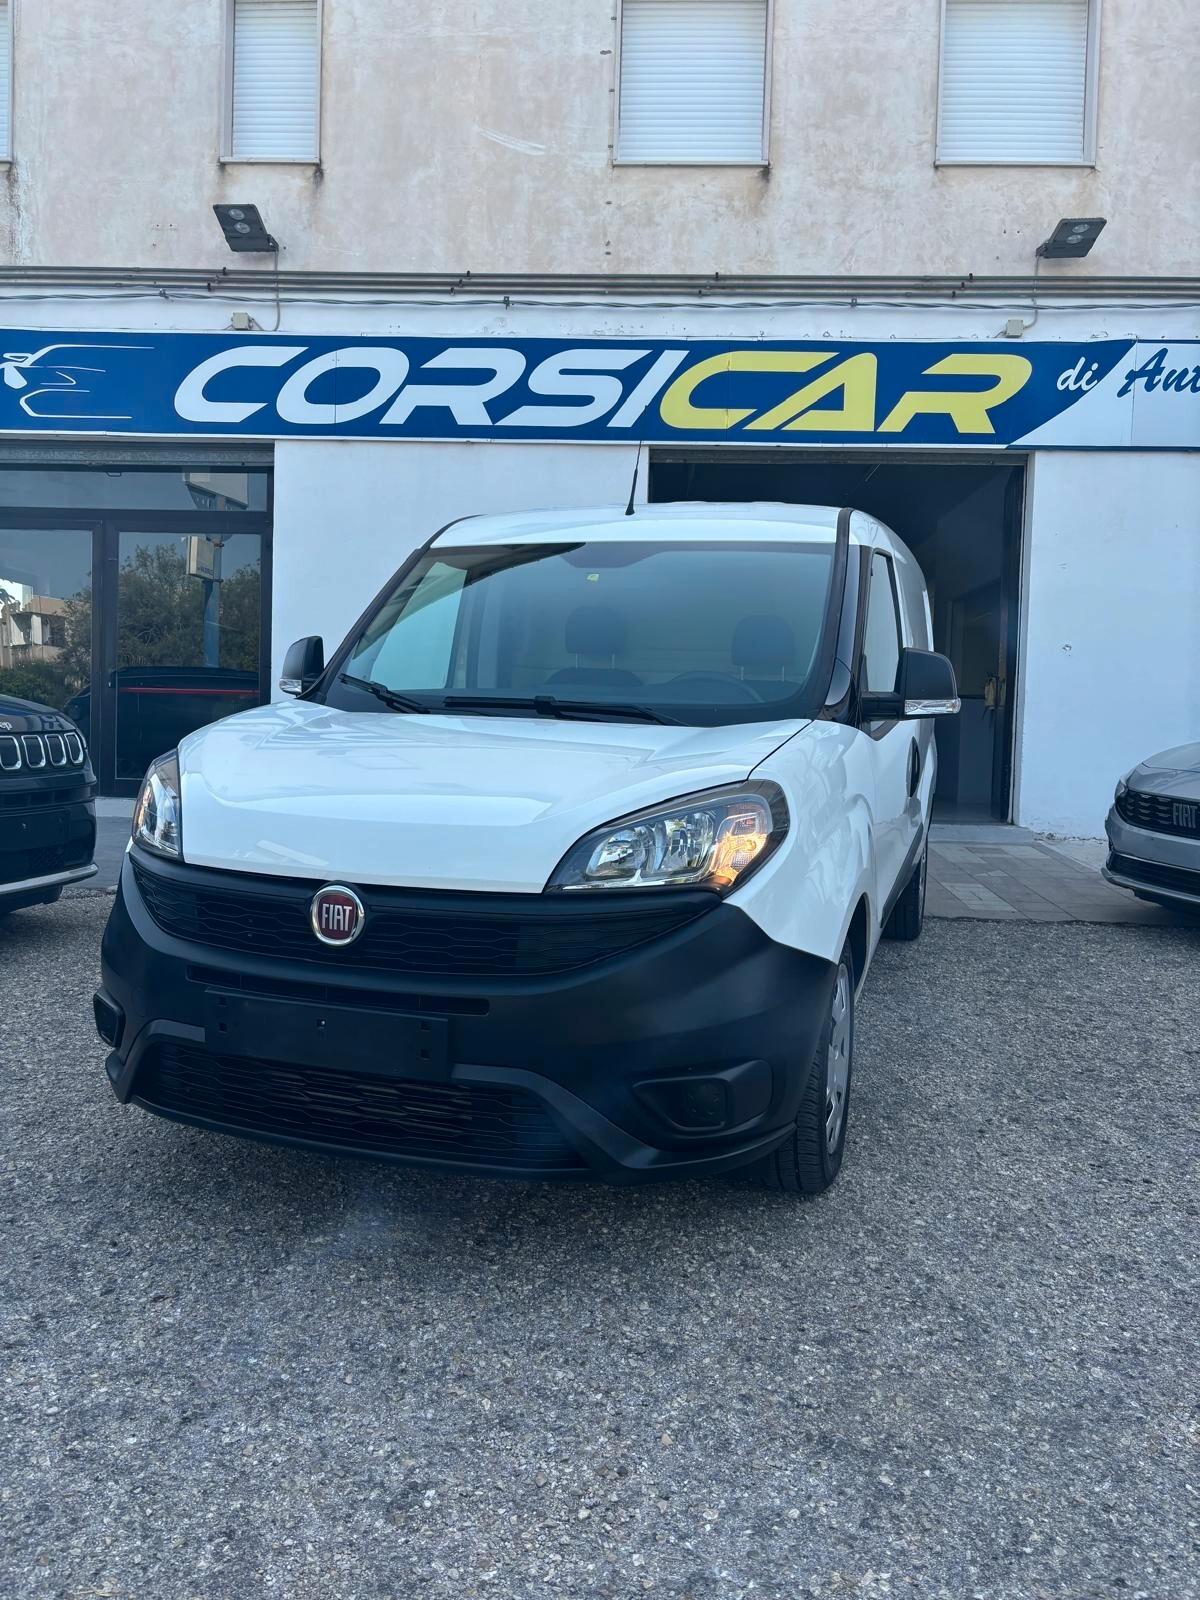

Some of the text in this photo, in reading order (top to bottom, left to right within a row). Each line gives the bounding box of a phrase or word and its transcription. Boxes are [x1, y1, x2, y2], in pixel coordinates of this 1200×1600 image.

[174, 345, 1032, 433] CORSICAR
[1056, 356, 1098, 391] di
[1172, 802, 1198, 829] FIAT
[322, 904, 352, 931] FIAT
